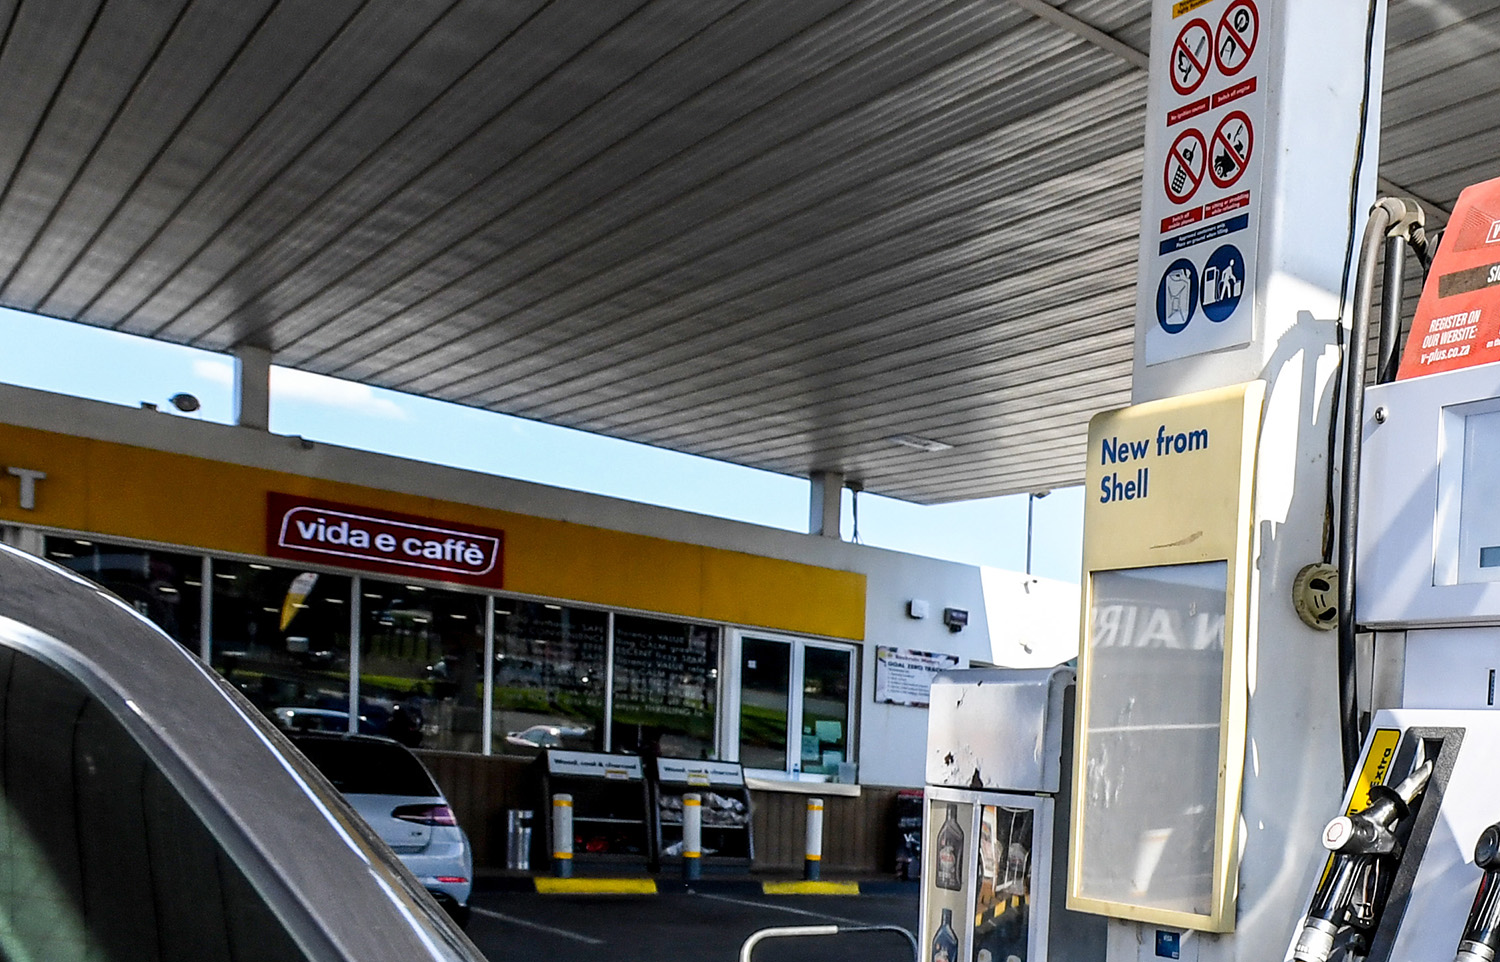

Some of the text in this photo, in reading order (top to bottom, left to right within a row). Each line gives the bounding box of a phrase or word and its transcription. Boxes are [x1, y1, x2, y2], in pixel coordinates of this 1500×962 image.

[1217, 92, 1230, 102] Switch
[1236, 85, 1251, 95] engine
[1428, 309, 1482, 333] REGISTER ON
[1422, 325, 1478, 349] OUR WEBSITE:
[1420, 344, 1471, 365] v-plus.co.za
[1101, 424, 1208, 466] New from
[1100, 467, 1149, 504] Shell
[296, 517, 485, 567] vida e caffè
